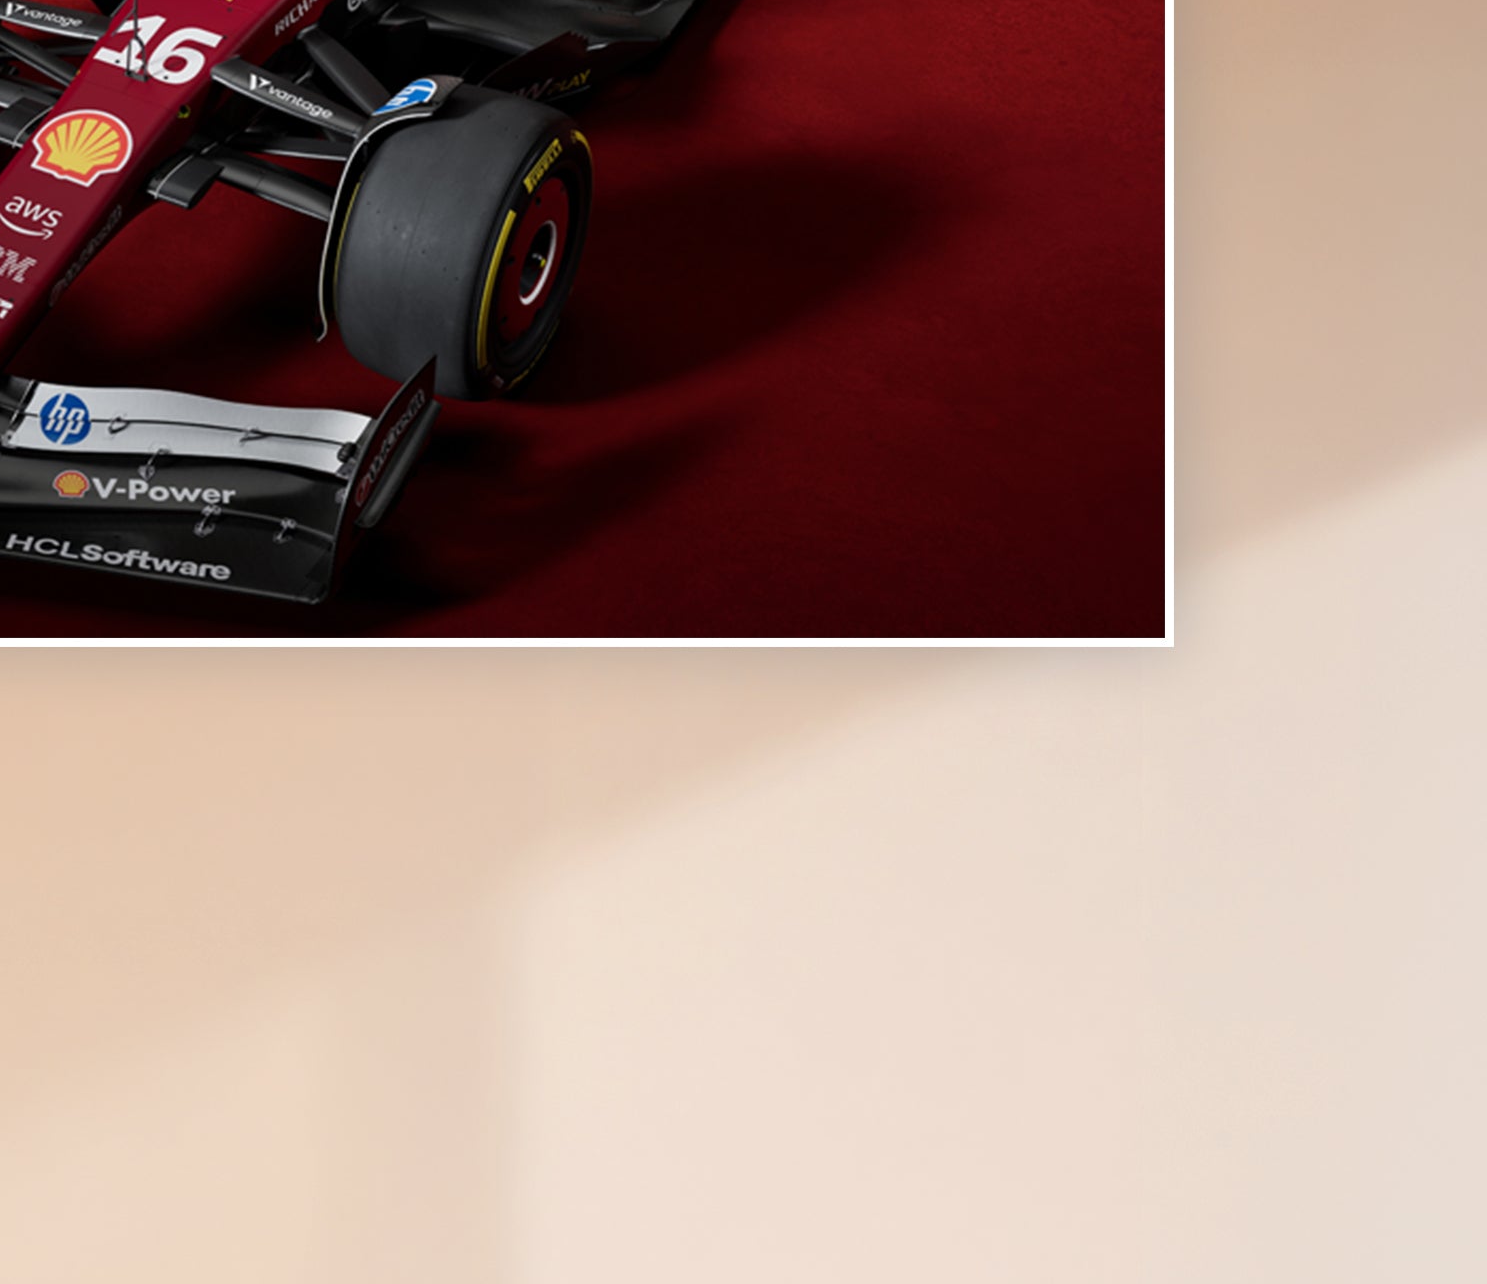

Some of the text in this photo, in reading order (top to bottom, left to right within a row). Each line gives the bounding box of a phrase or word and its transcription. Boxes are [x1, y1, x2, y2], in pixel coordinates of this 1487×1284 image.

[22, 7, 83, 28] vantage
[93, 15, 223, 85] 16
[267, 83, 334, 119] vantage
[523, 137, 563, 194] PIRELLI
[5, 195, 63, 228] aws
[39, 393, 91, 445] hp
[92, 478, 236, 504] V-Power
[6, 534, 231, 581] HCLSoftware
